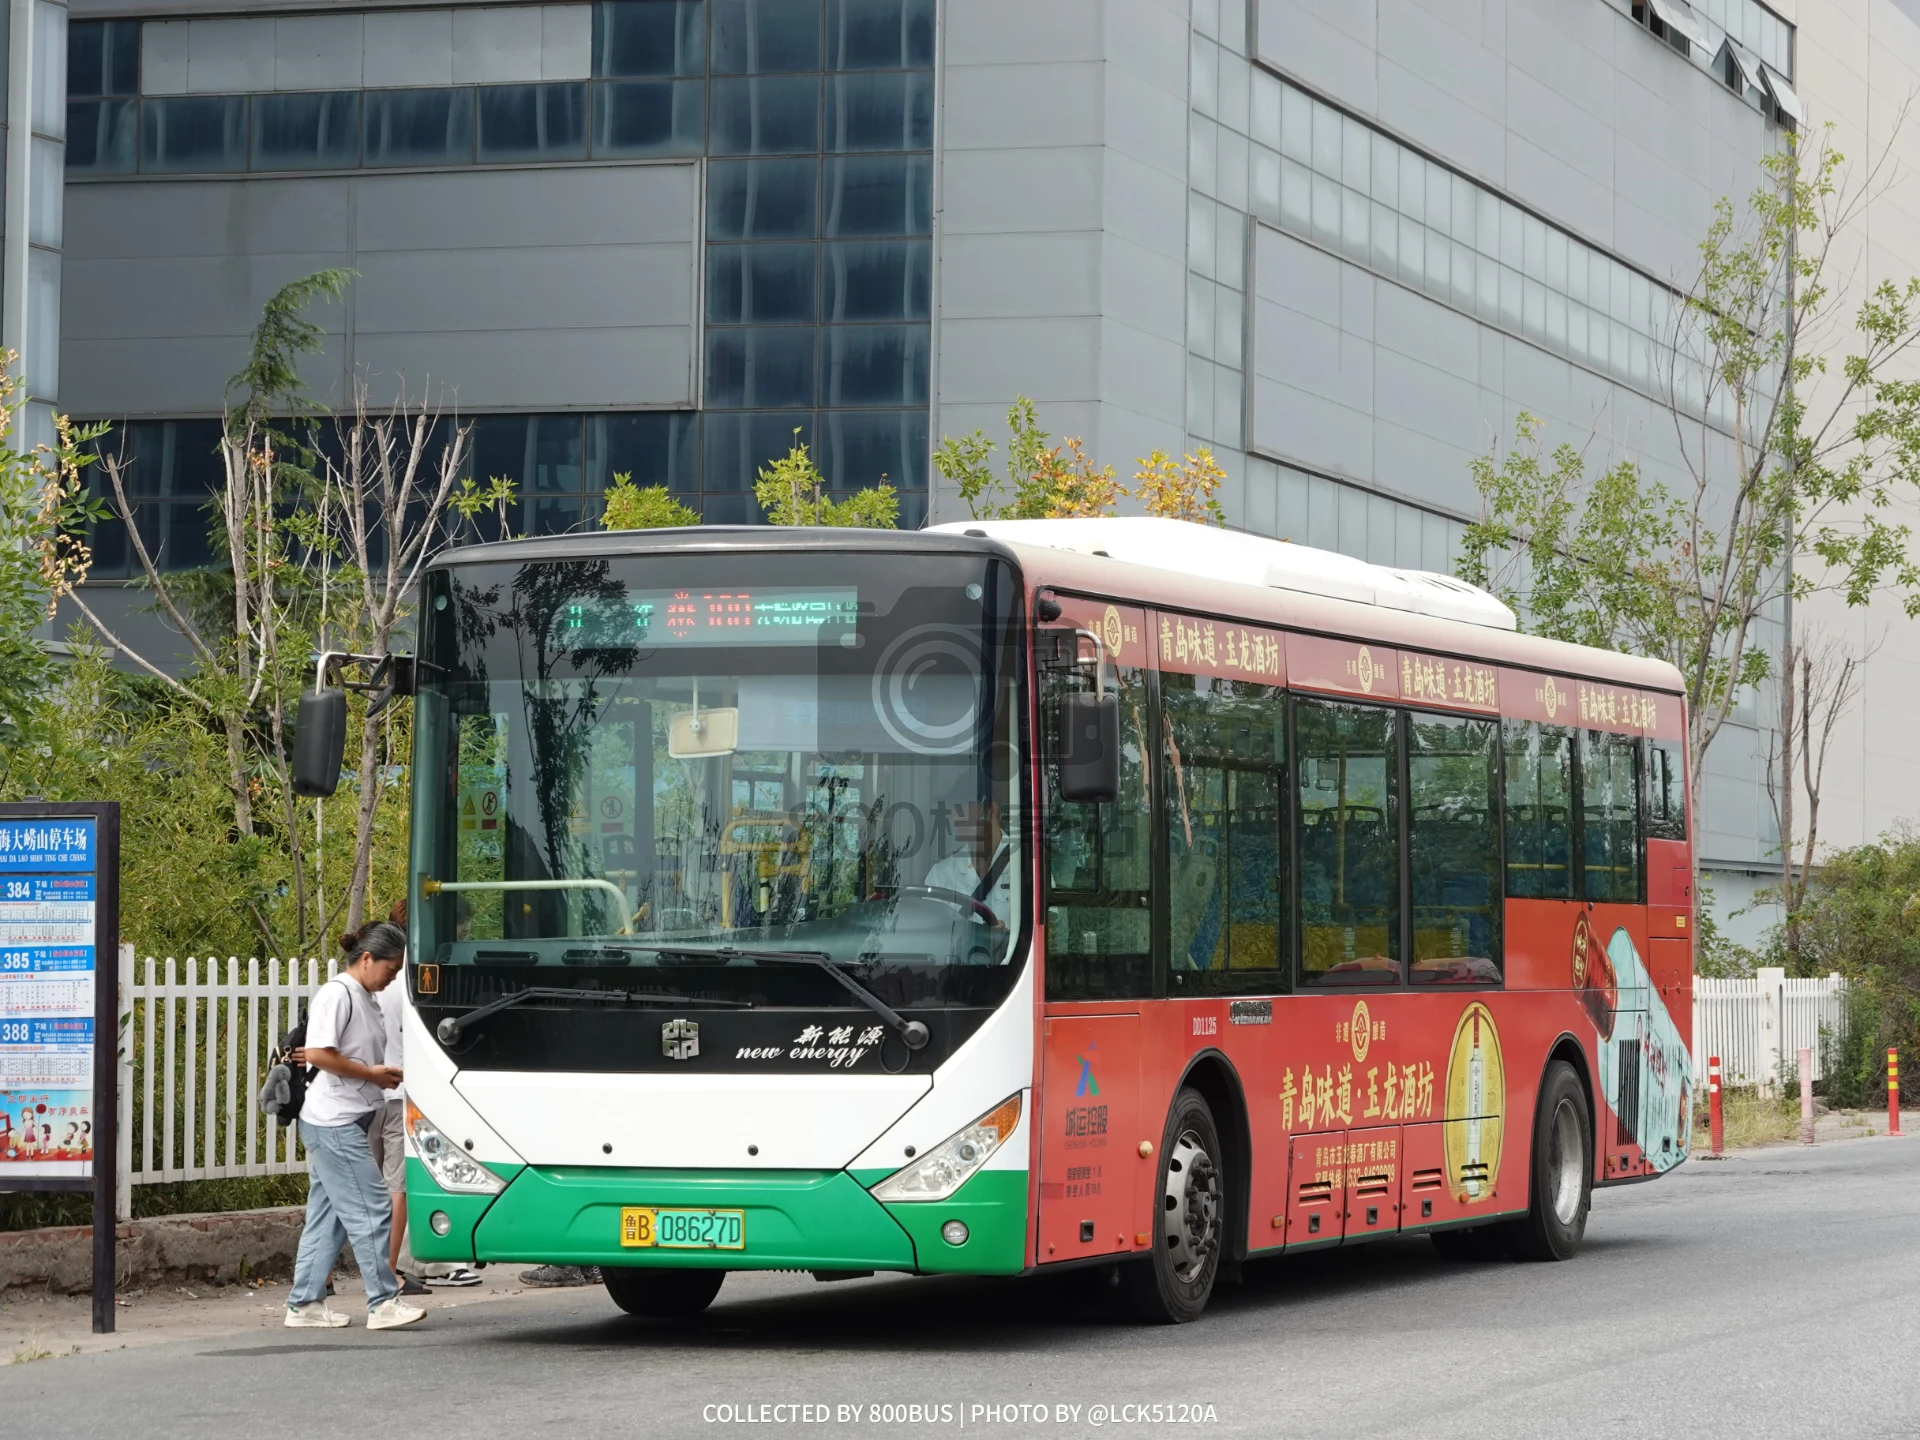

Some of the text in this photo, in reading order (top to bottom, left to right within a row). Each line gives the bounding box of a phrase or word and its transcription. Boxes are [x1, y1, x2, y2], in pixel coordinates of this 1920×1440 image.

[9, 855, 17, 863] DA
[18, 855, 29, 863] LAO
[30, 854, 43, 862] SHAN
[45, 854, 56, 862] TING
[58, 854, 68, 862] CHE
[70, 854, 87, 862] CHANG
[7, 881, 31, 899] 384
[35, 880, 48, 888] 下站
[4, 952, 30, 969] 385
[34, 950, 46, 958] 下站
[2, 1023, 29, 1041] 388
[34, 1022, 47, 1030] 下站
[793, 1024, 884, 1046] 新能源
[736, 1045, 868, 1068] new energy
[7, 1094, 50, 1104] 文明出行
[1065, 1105, 1108, 1137] 城运控股
[661, 1215, 741, 1243] 08627D
